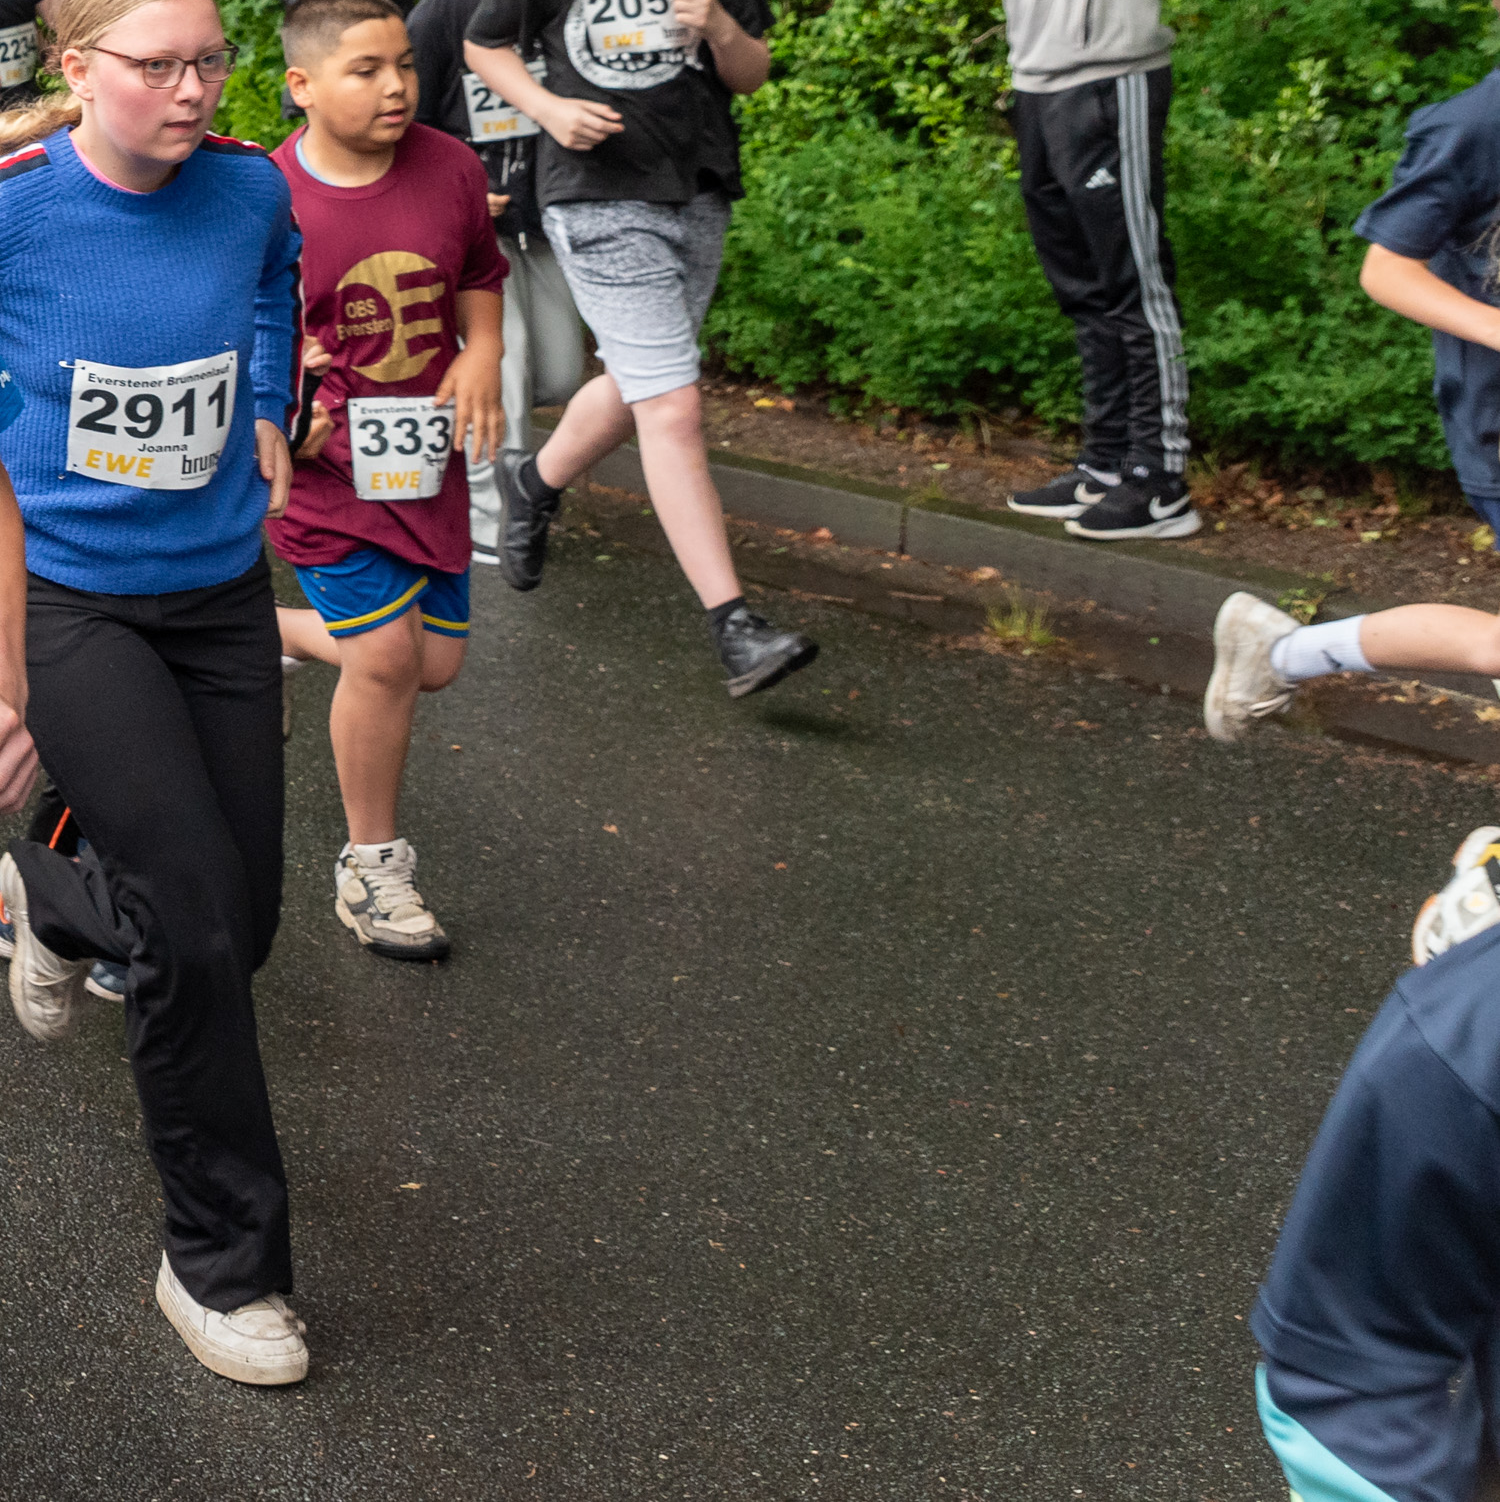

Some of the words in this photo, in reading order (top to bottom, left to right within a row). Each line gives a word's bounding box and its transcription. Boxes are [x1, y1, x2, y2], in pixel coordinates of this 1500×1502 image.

[344, 298, 379, 320] OBS
[335, 317, 395, 341] Eversten
[87, 372, 164, 389] Everstener
[166, 363, 230, 387] Brunnenlauf
[75, 379, 228, 440] 2911
[137, 443, 189, 453] Joanna
[357, 415, 451, 457] 333
[85, 448, 155, 479] EWE
[369, 470, 422, 491] EWE
